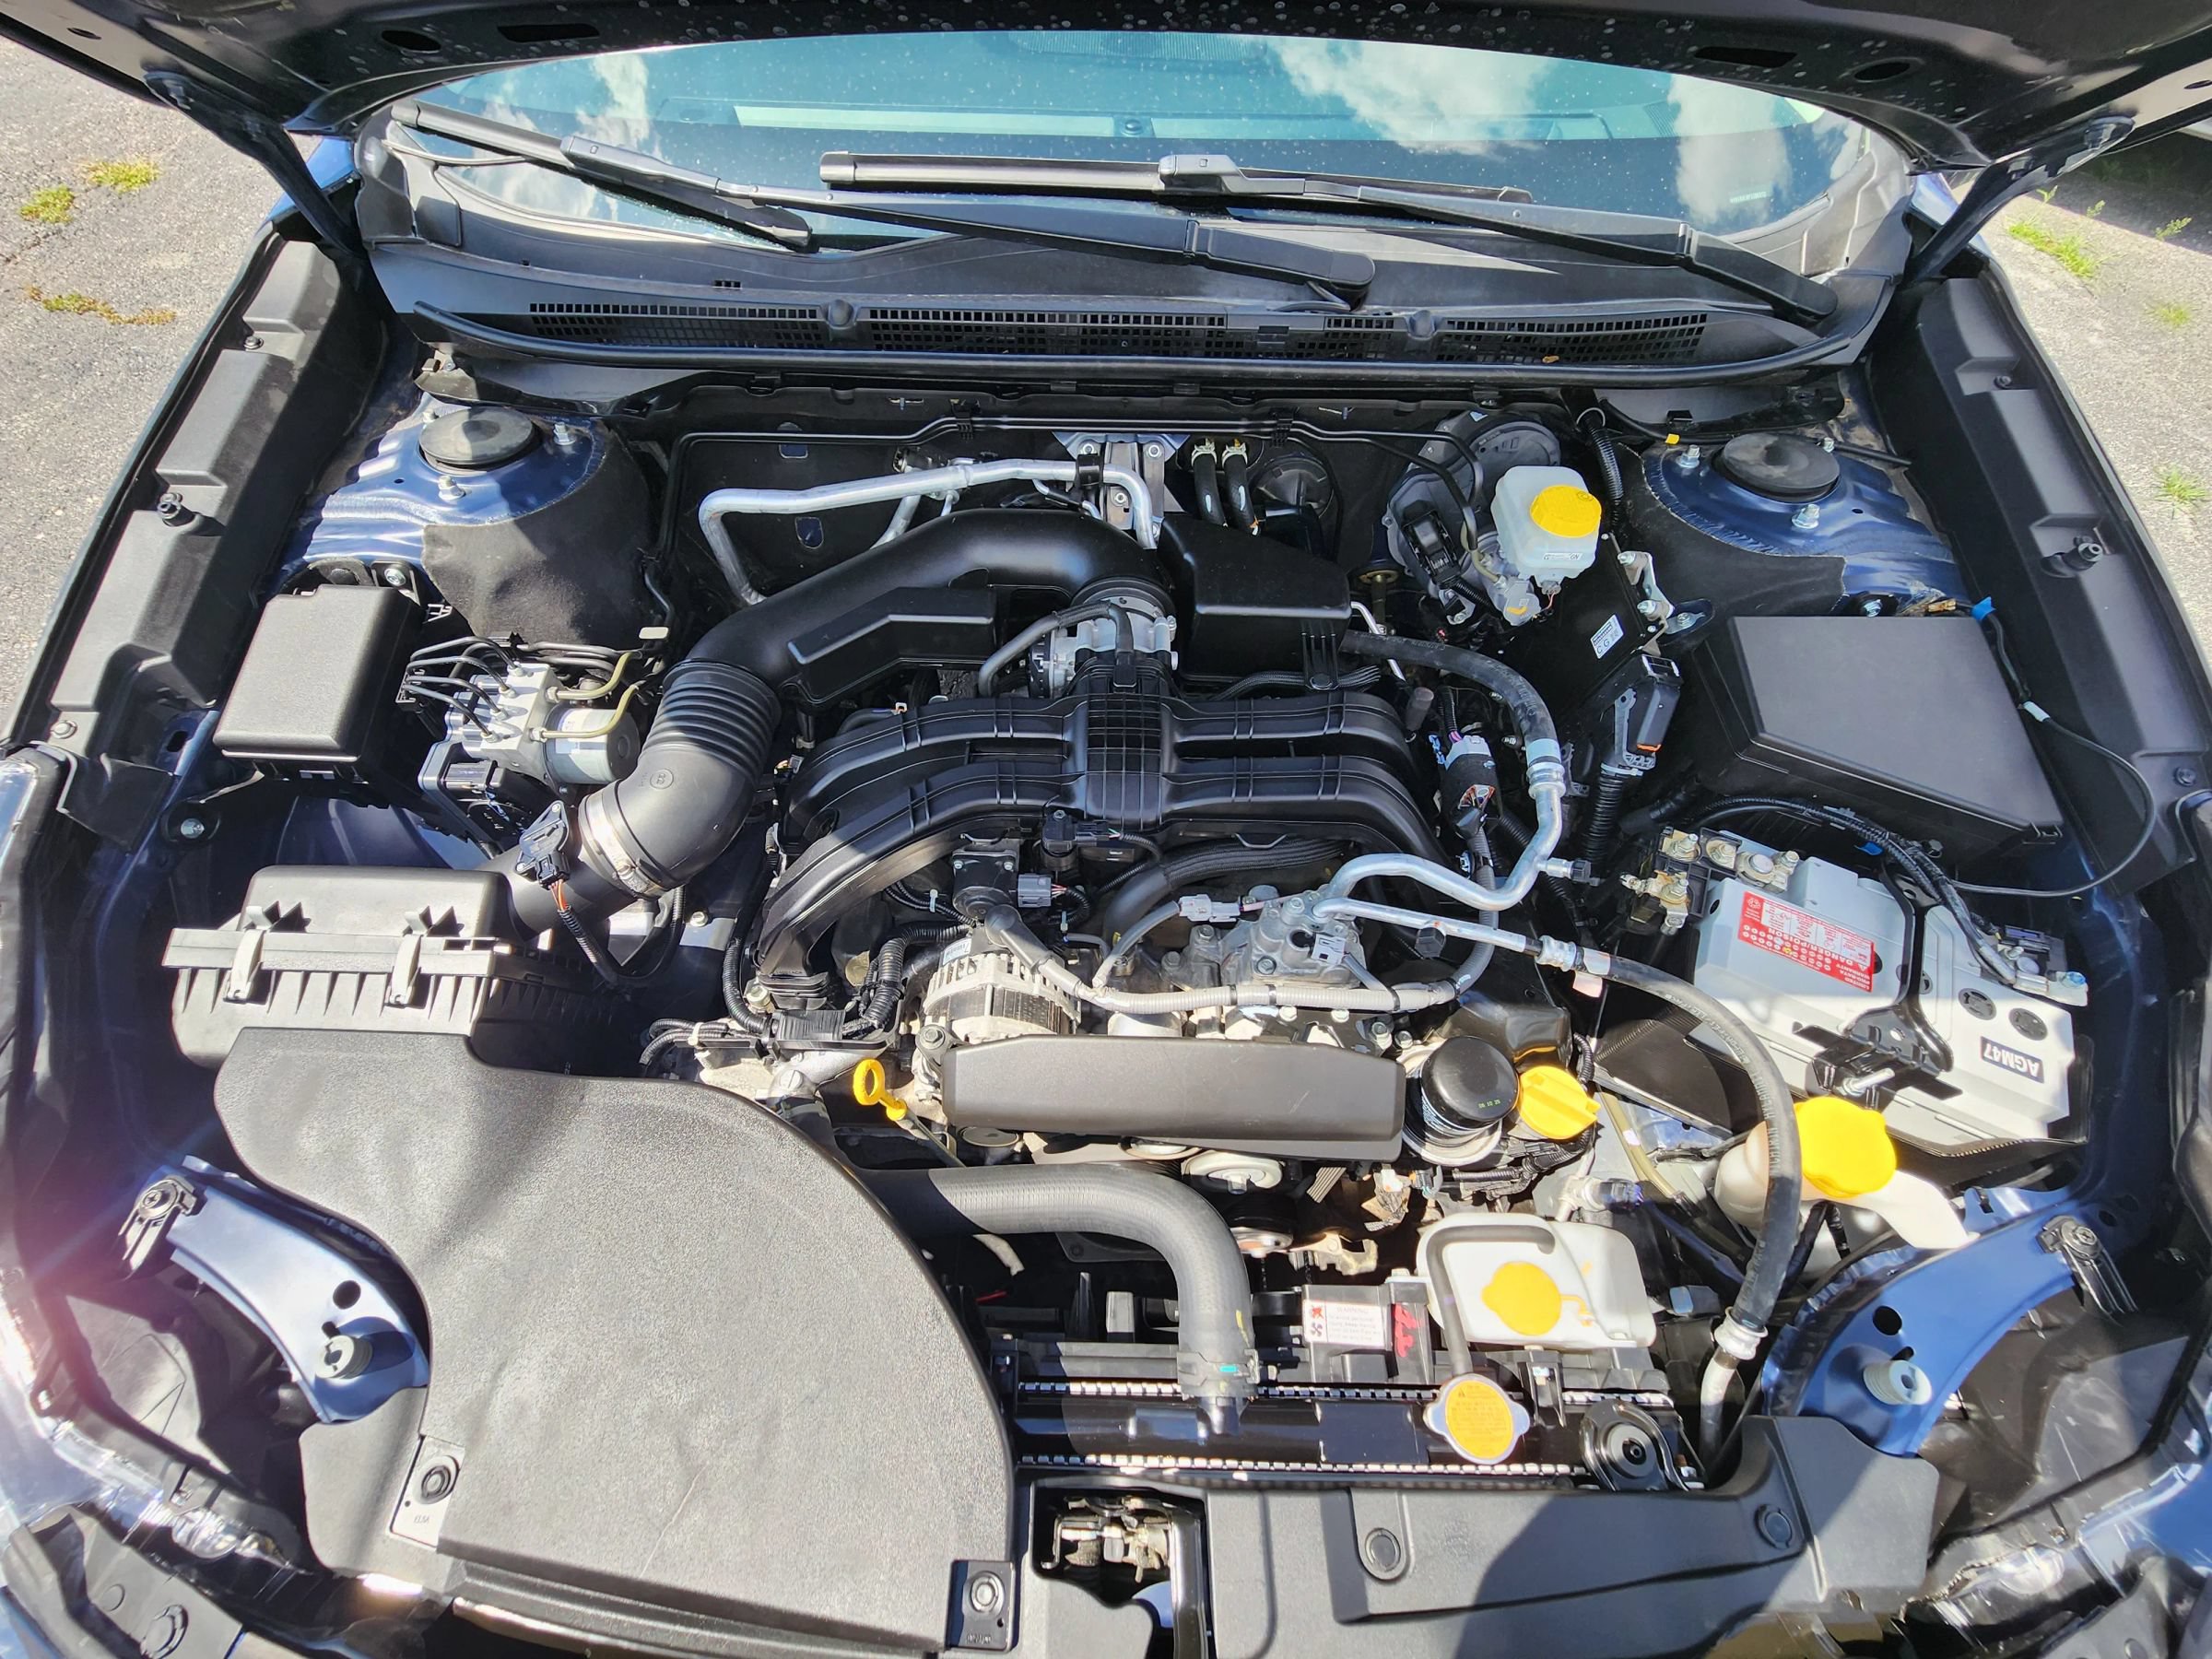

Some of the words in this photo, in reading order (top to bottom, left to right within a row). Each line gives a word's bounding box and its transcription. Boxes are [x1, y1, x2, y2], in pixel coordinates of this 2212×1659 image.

[1768, 927, 1853, 966] DANGER/POISON
[1835, 963, 1870, 980] WARRANTY
[1839, 970, 1870, 985] PRO-RATA
[1844, 977, 1870, 990] LIMITED
[1983, 1043, 2040, 1077] AGM47
